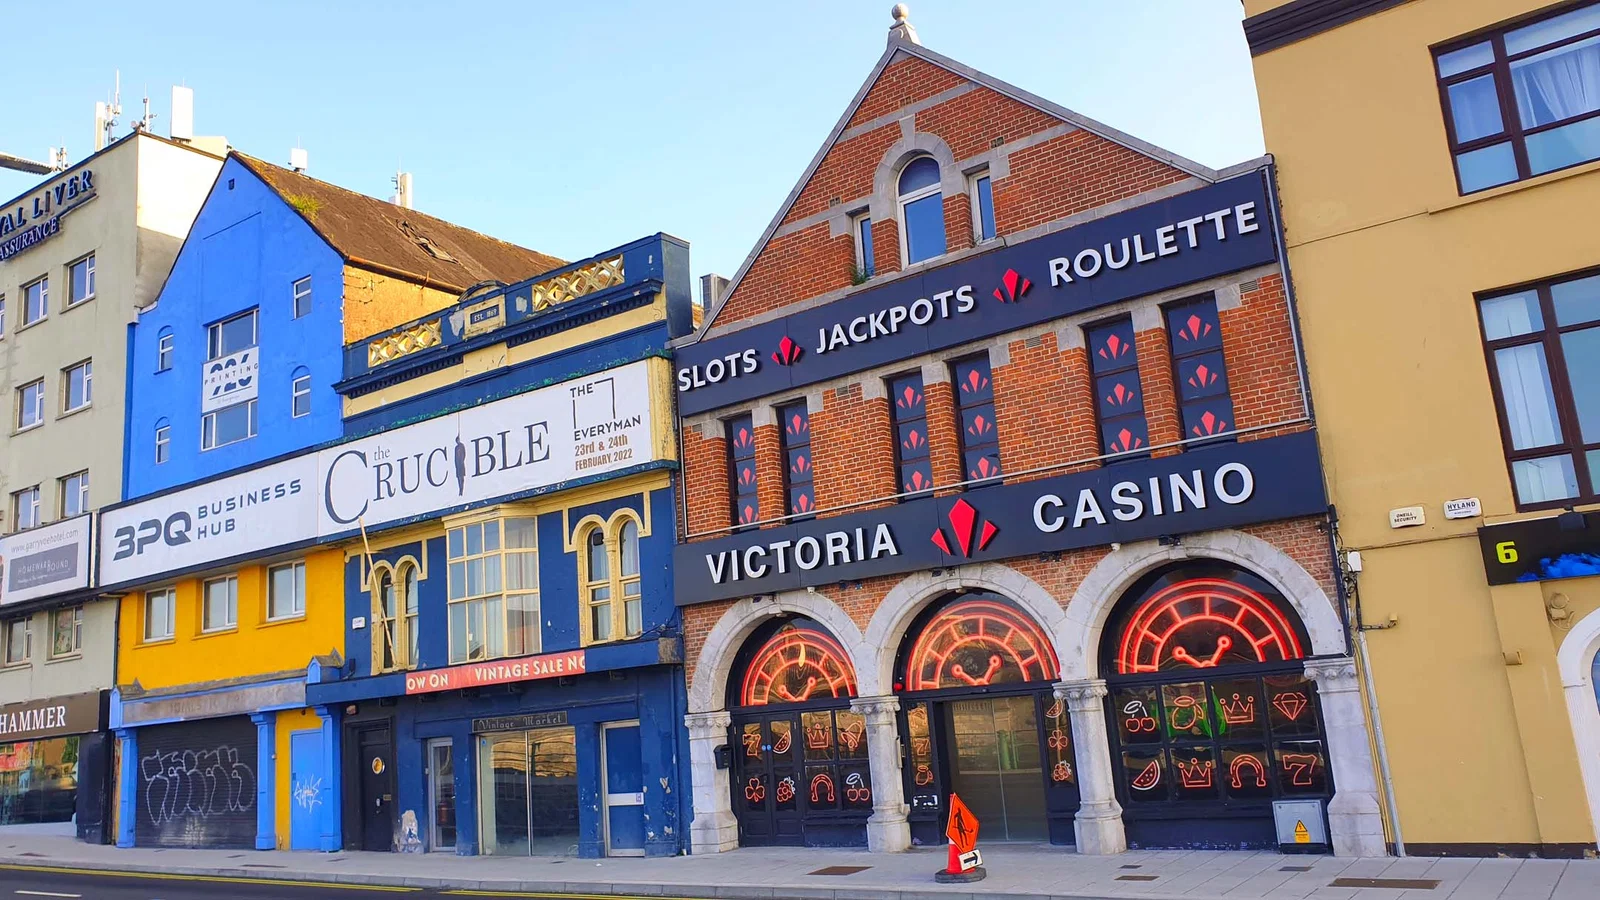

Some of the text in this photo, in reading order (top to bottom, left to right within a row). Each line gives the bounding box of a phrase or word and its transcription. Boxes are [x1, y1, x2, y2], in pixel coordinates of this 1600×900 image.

[32, 170, 94, 219] LIVER
[678, 201, 1259, 392] SLOTS JACKPOTS ROULETTE
[204, 362, 259, 386] PRINTING
[569, 382, 594, 398] THE
[574, 414, 641, 441] EVERYMAN
[373, 445, 391, 461] the
[574, 434, 628, 457] 23rd & 24th
[613, 448, 633, 462] 2022
[198, 478, 302, 520] BUSINESS
[1447, 501, 1476, 512] HYLAND
[197, 518, 236, 540] HUB
[705, 462, 1254, 584] VICTORIA CASINO
[113, 511, 192, 562] 3PQ
[1495, 541, 1519, 564] 6
[407, 677, 426, 691] OW
[429, 673, 448, 689] ON
[475, 663, 529, 682] VINTAGE
[532, 656, 563, 676] SALE
[0, 705, 67, 735] HAMMER
[478, 713, 562, 730] Vintage Market
